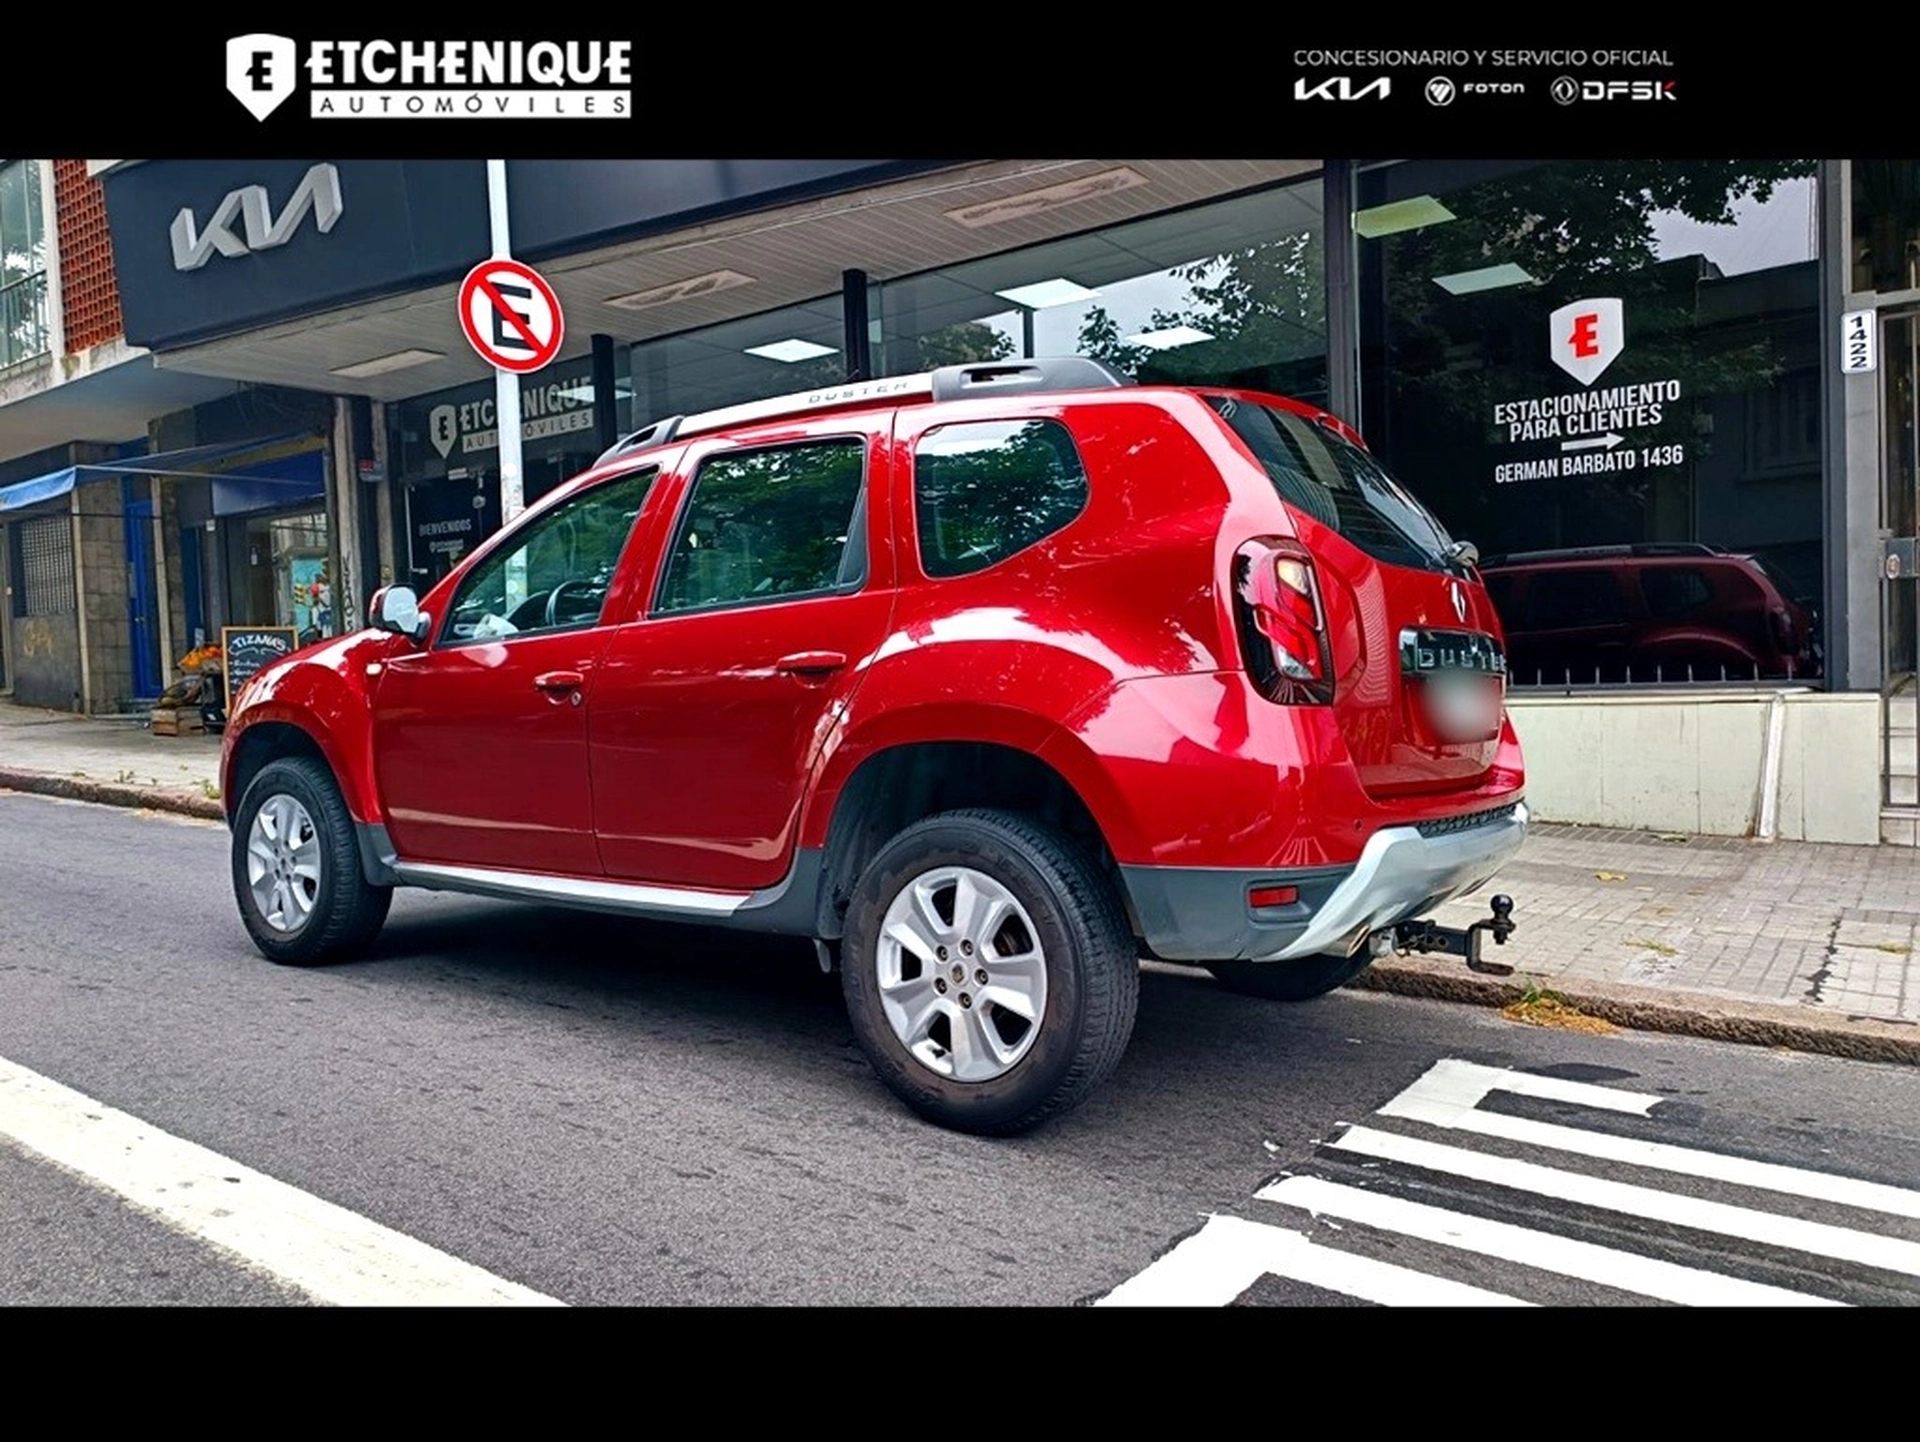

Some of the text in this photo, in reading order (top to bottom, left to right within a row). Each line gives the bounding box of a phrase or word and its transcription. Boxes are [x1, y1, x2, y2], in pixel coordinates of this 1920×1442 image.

[170, 162, 343, 272] KIA
[1849, 315, 1868, 369] 1422
[808, 382, 908, 404] DUSTER
[1494, 379, 1681, 425] ESTACIONAMIENTO
[1510, 402, 1663, 443] PARA CLIENTES
[1494, 444, 1684, 484] GERMAN BARBATO 1436
